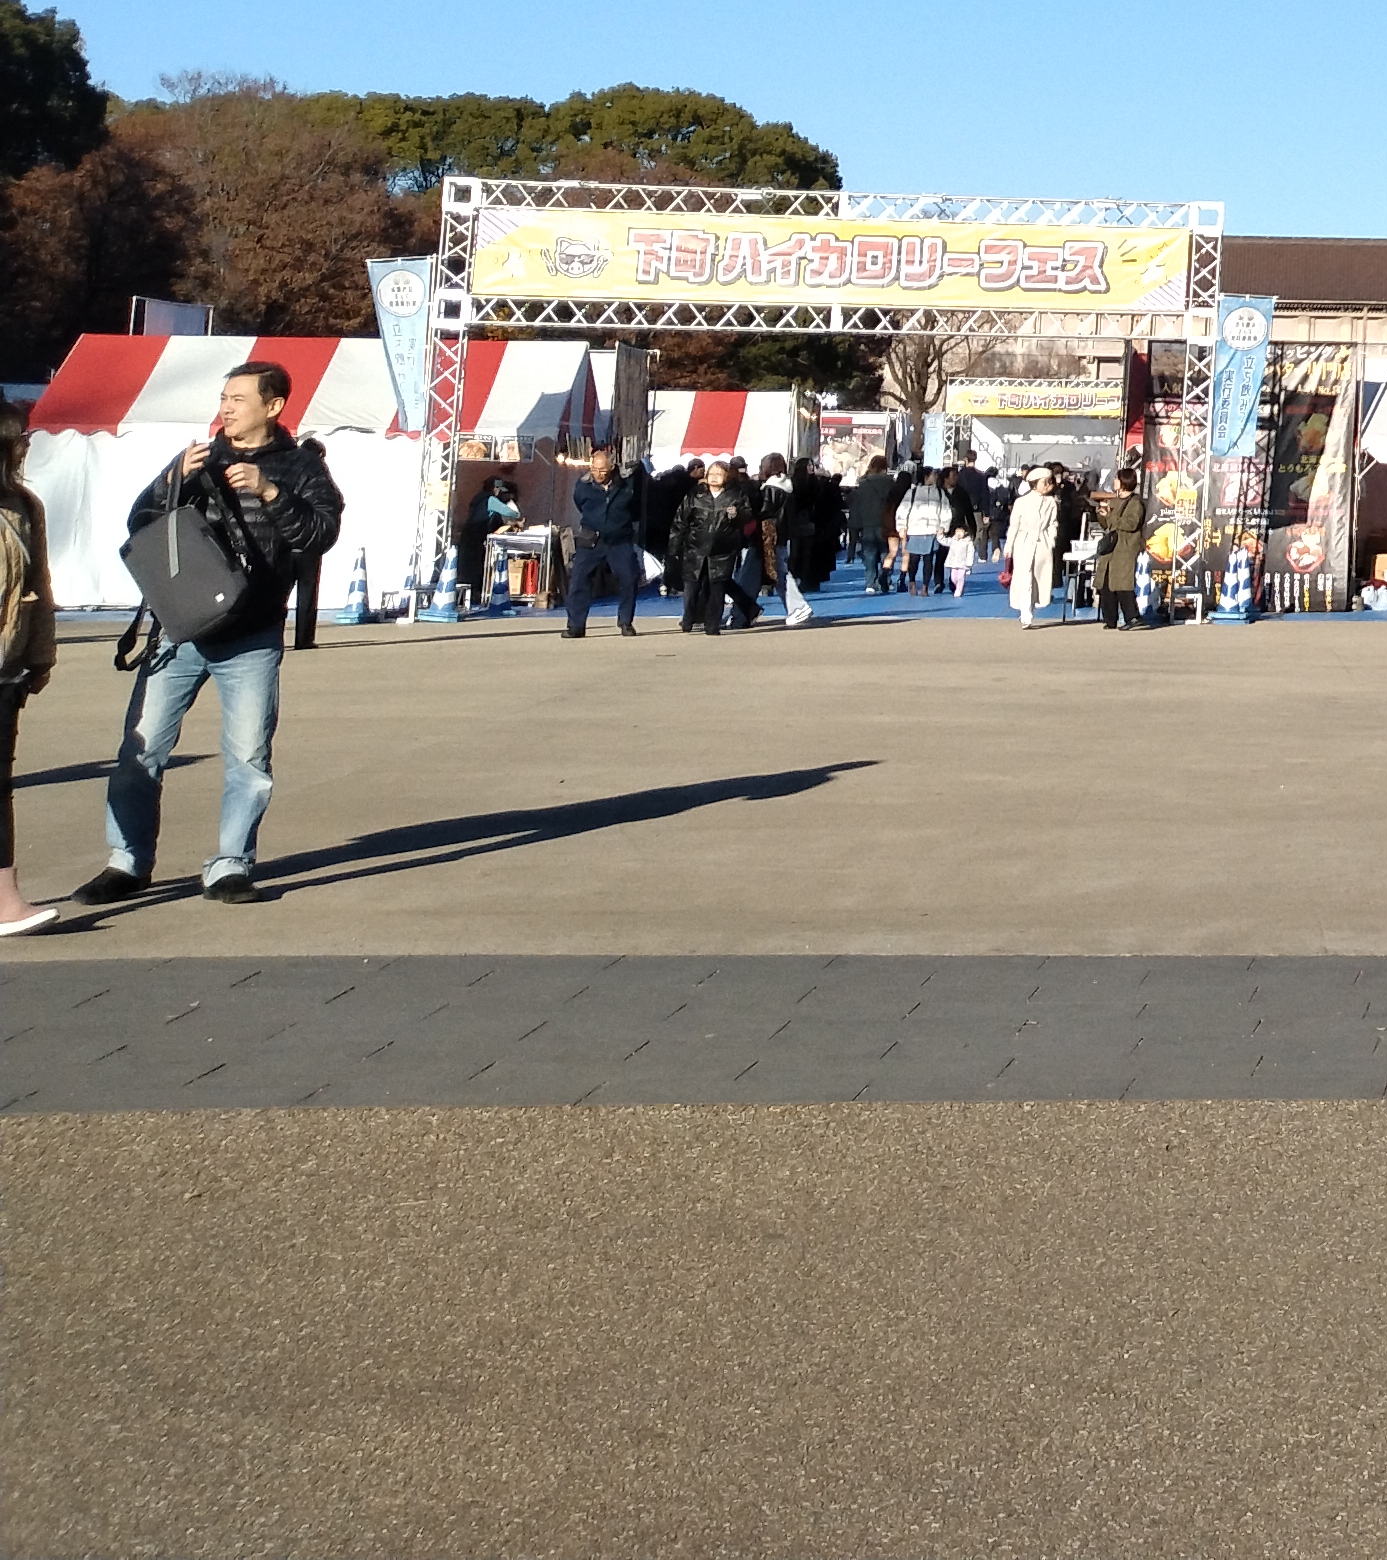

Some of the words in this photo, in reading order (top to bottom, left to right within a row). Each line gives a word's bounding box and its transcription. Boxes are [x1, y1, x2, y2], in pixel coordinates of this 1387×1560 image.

[628, 228, 1110, 292] 下町ハイカロリーフェス
